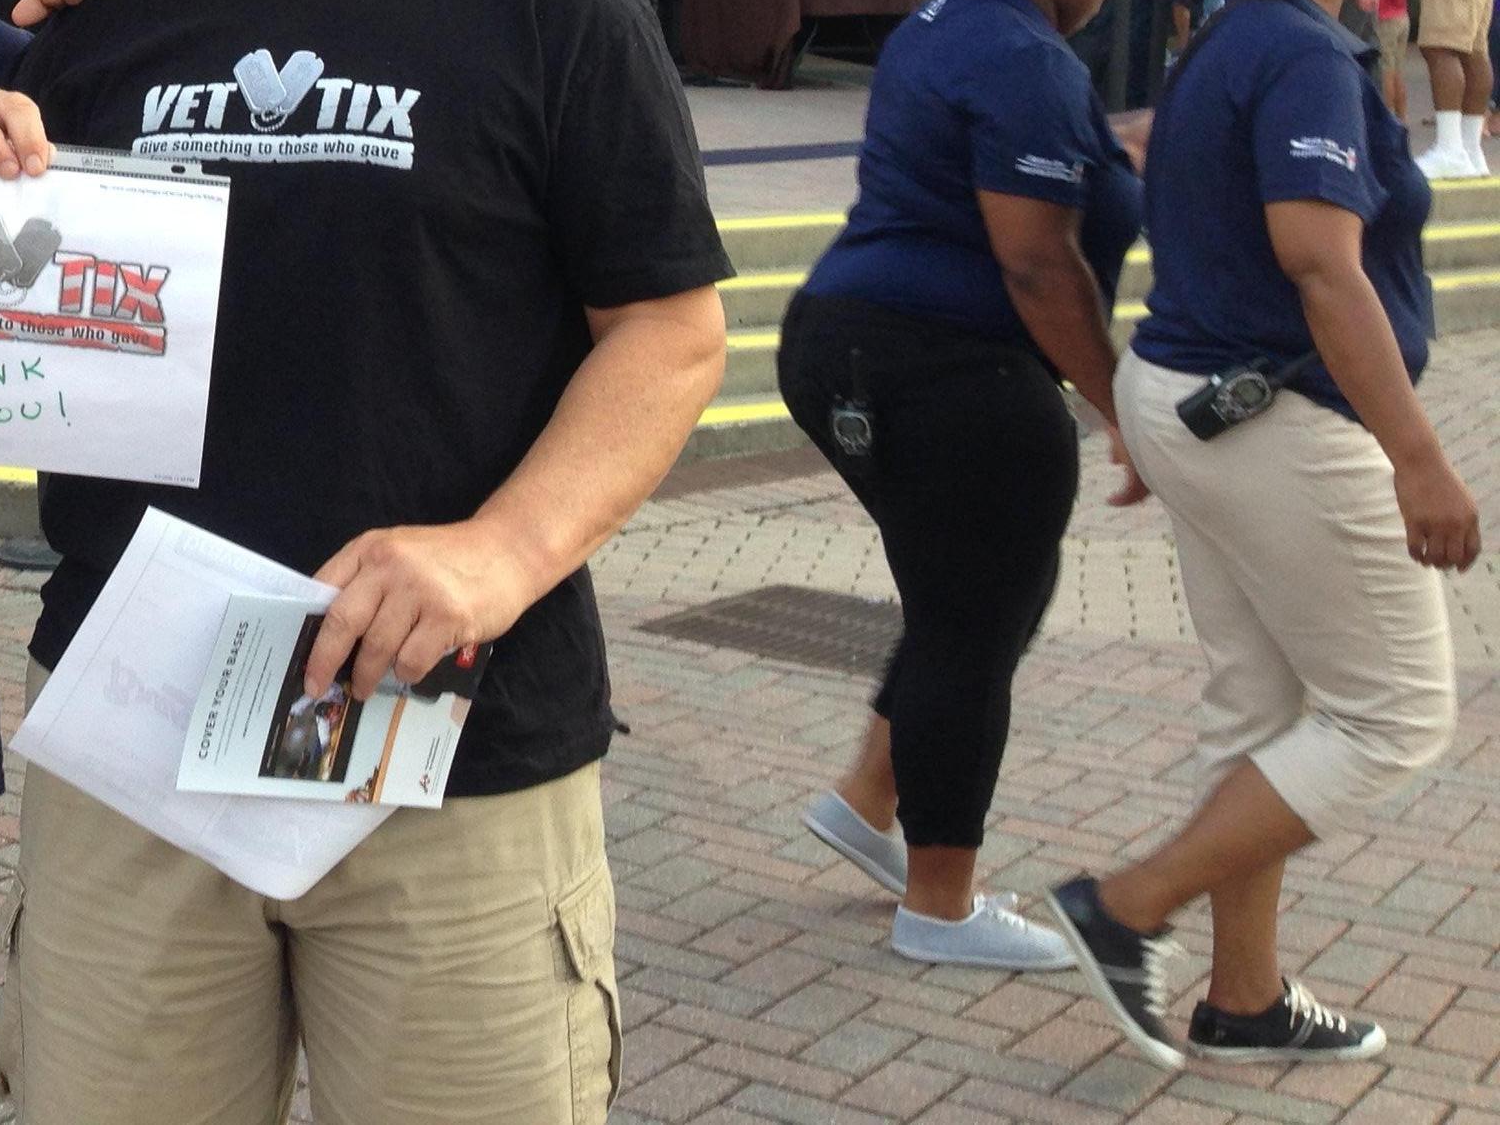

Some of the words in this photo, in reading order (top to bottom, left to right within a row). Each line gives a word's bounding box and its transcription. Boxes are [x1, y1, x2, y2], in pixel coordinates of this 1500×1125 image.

[141, 81, 238, 134] VET
[316, 78, 421, 139] TIX
[140, 140, 167, 155] Give
[173, 138, 252, 157] something
[258, 141, 273, 156] to
[278, 140, 318, 156] those
[324, 140, 354, 155] who
[360, 144, 400, 161] gave
[53, 251, 172, 324] TIX
[20, 318, 65, 338] those
[70, 324, 106, 342] who
[110, 329, 152, 348] gave
[198, 706, 218, 761] COVER
[213, 668, 233, 706] YOUR
[226, 621, 249, 666] BASES
